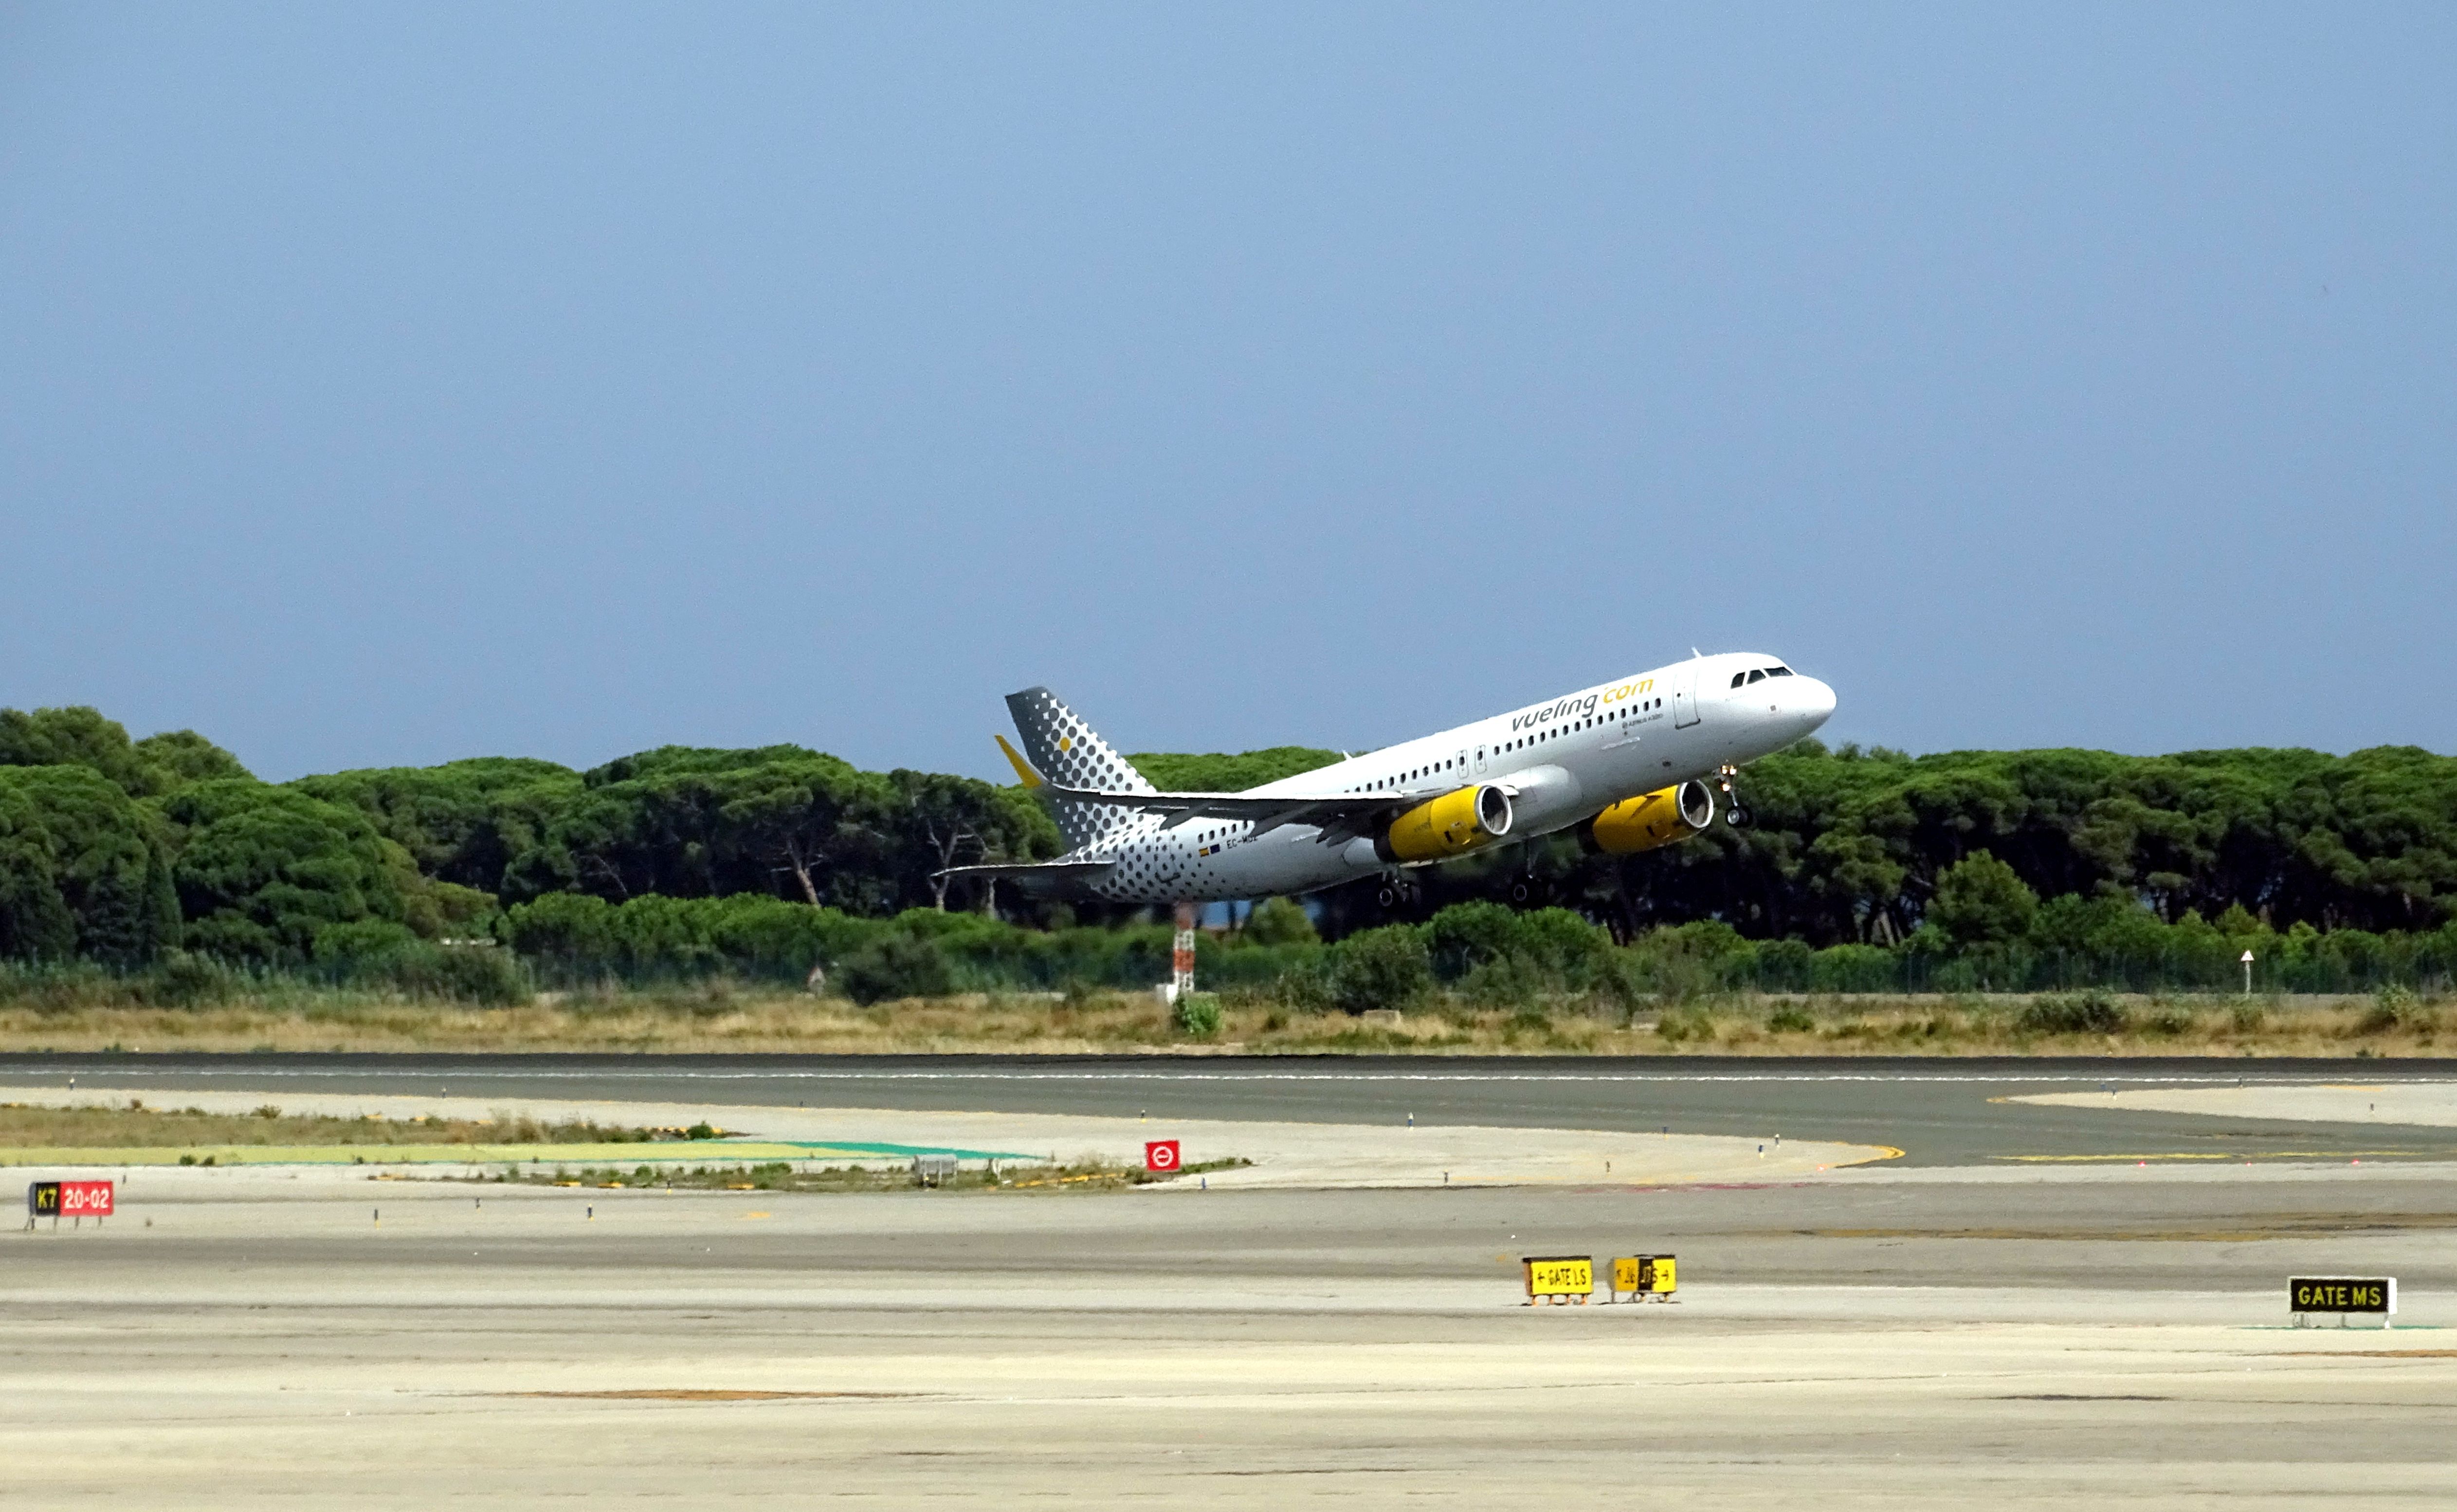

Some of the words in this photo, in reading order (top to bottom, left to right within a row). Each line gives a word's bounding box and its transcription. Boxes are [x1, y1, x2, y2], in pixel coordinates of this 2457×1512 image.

[37, 1187, 57, 1208] K7
[64, 1187, 109, 1209] 20-02
[1548, 1268, 1571, 1285] GATE
[2297, 1286, 2348, 1306] GATE
[2352, 1286, 2382, 1306] MS
